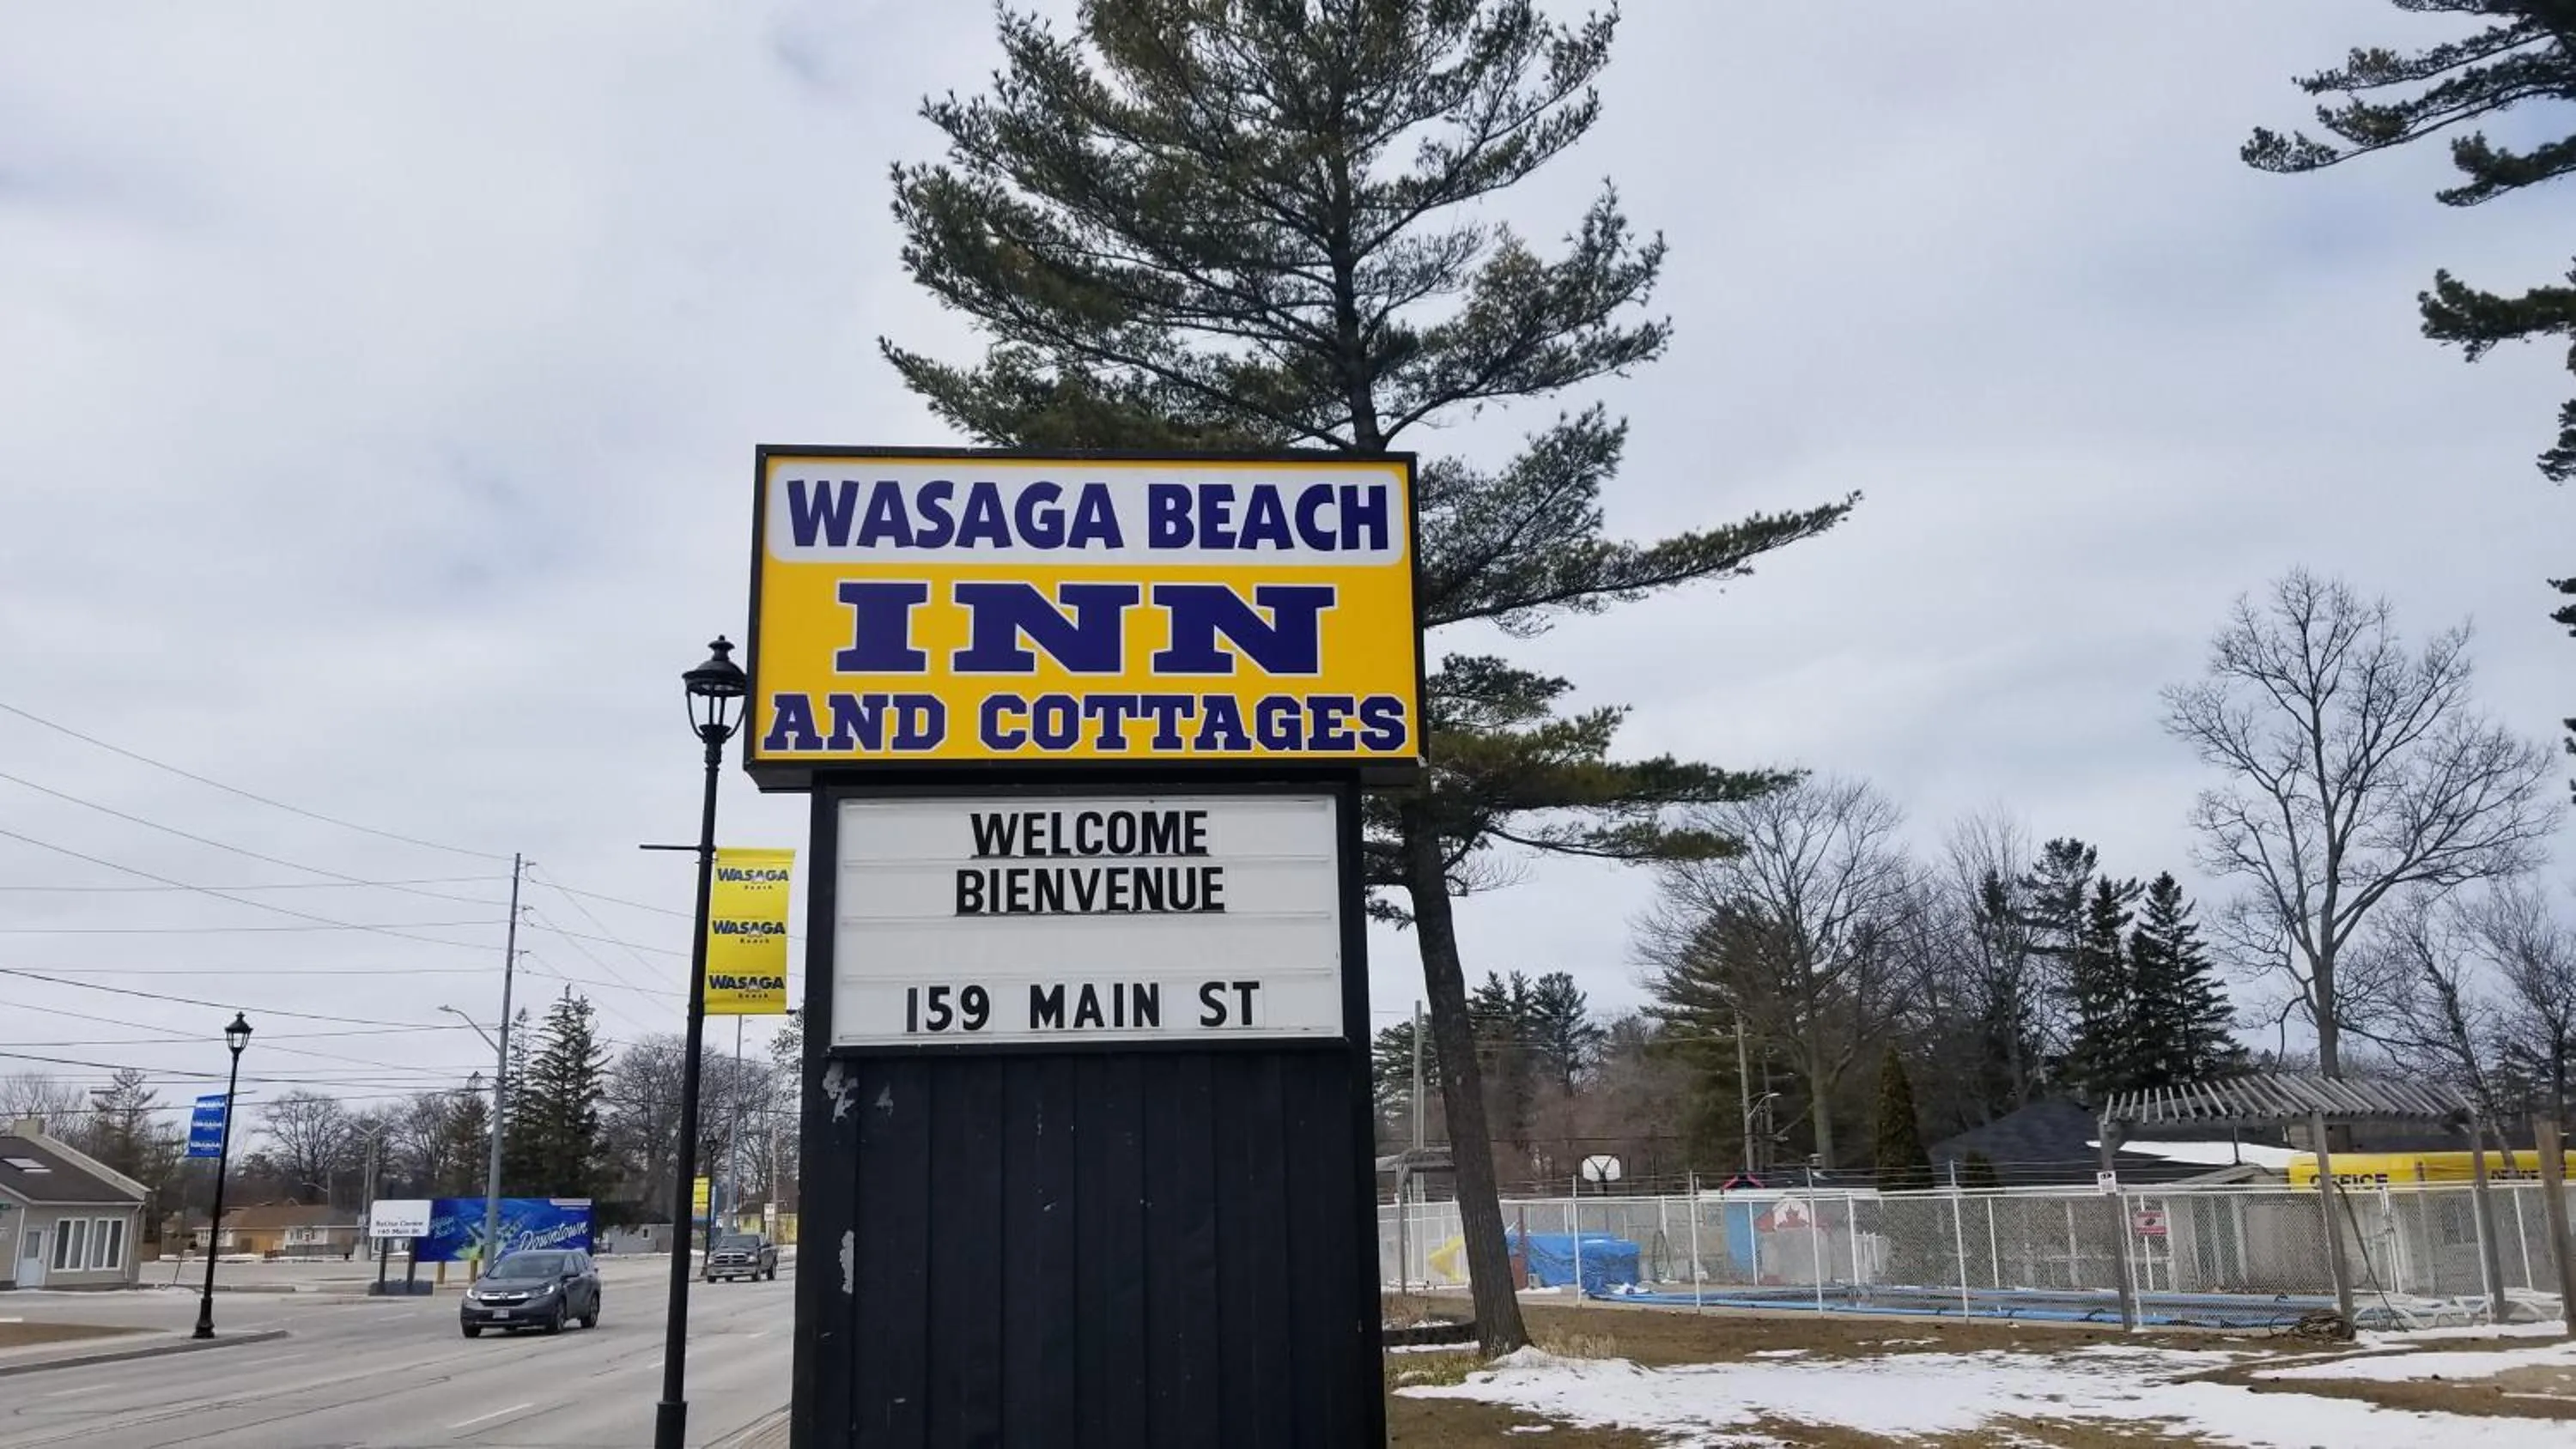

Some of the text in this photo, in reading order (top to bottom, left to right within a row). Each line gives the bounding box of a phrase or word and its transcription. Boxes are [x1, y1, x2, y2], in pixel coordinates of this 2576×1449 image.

[787, 480, 1388, 552] WASAGA BEACH
[835, 581, 1337, 675] INN
[763, 693, 1406, 752] AND COTTAGES
[970, 811, 1208, 856] WELCOME
[717, 868, 789, 882] WASAGA
[956, 867, 1225, 913] BIENVENUE
[712, 919, 786, 935] WASAGA
[708, 974, 786, 990] WASAGA
[906, 980, 1260, 1033] 159 MAIN ST
[519, 1222, 588, 1251] Downtown
